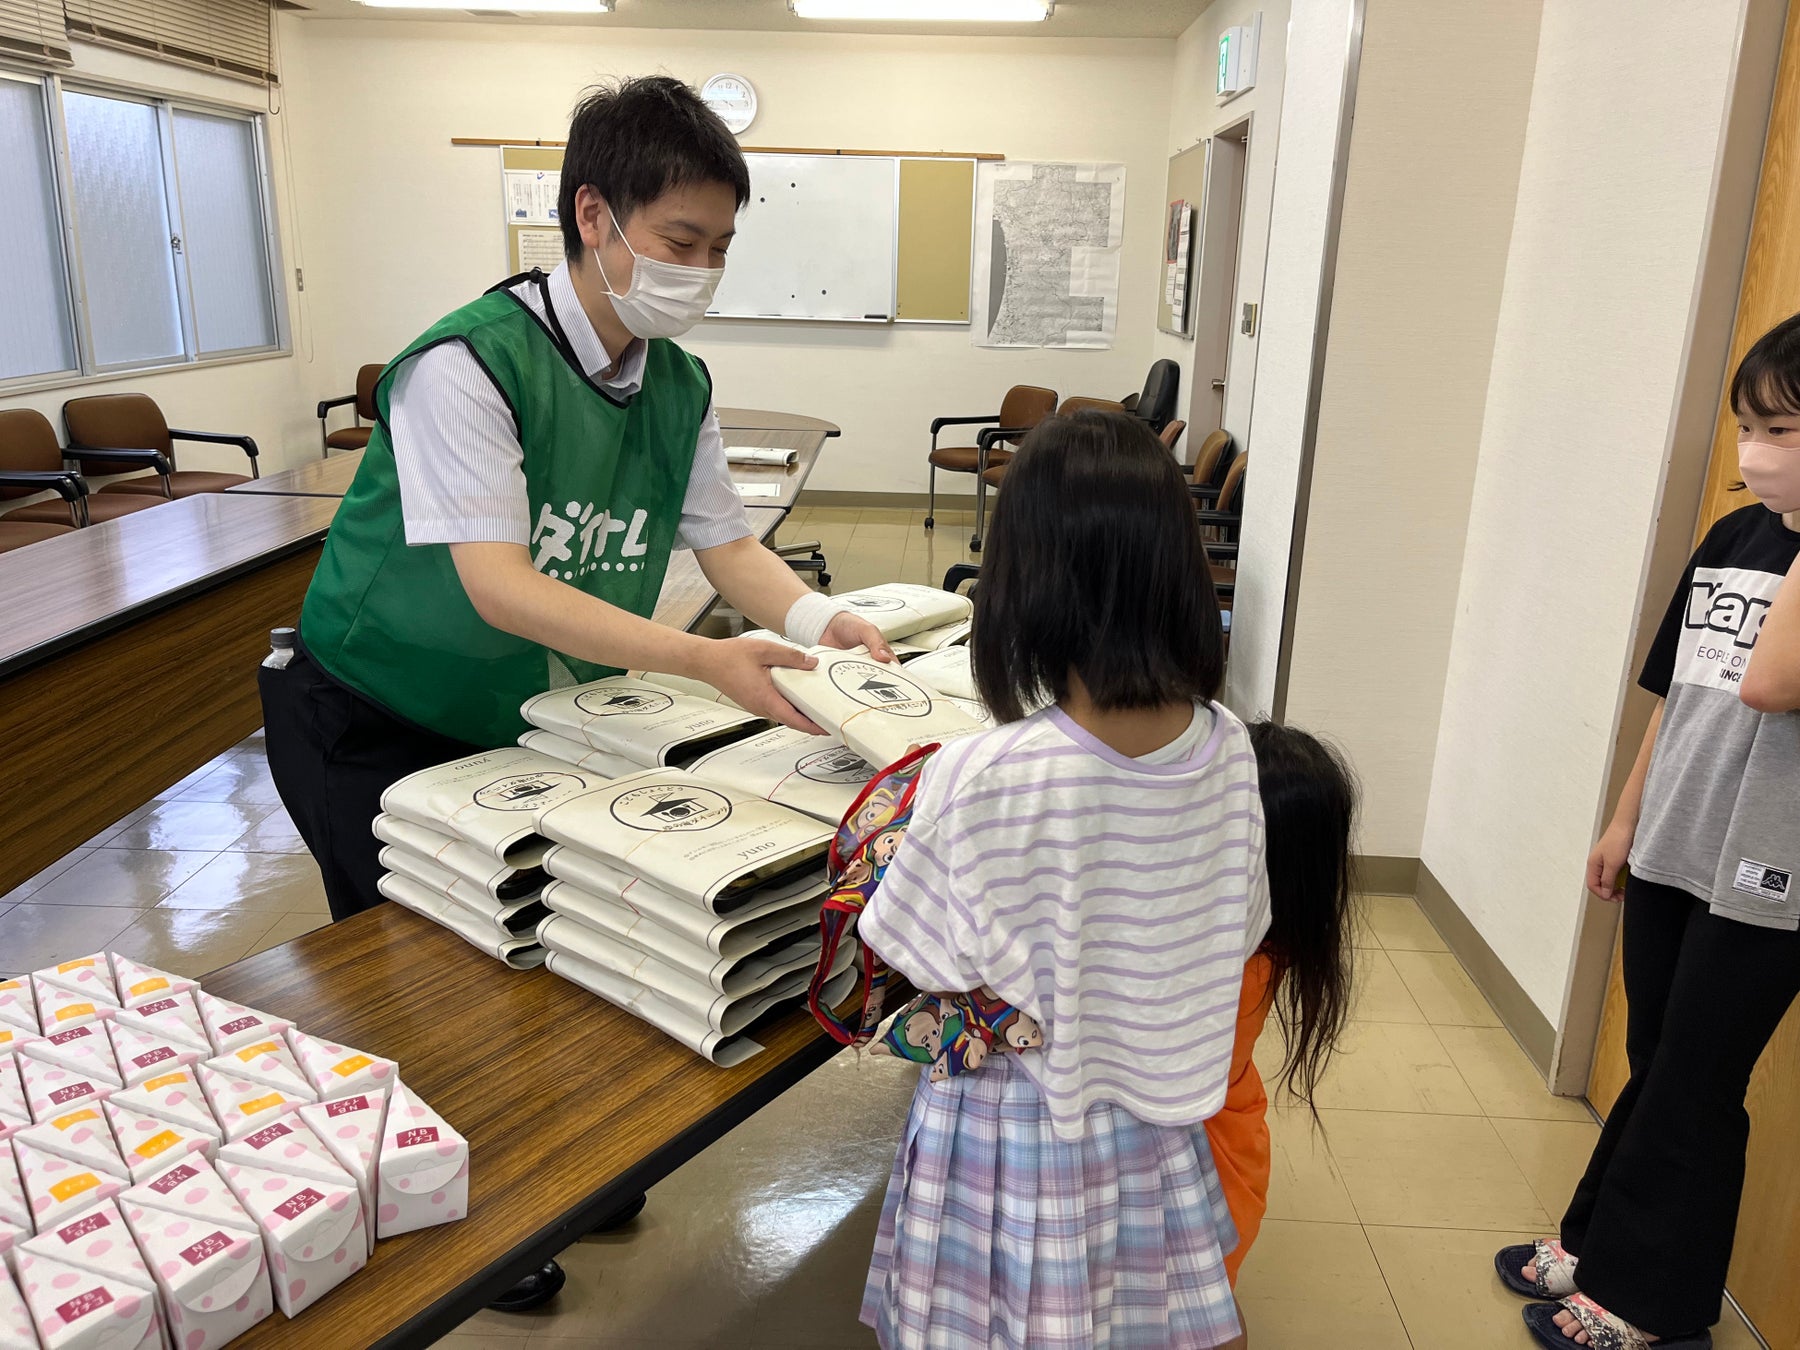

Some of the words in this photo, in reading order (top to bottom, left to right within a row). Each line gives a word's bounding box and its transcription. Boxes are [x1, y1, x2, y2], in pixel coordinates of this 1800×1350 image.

[454, 756, 493, 771] yuno
[736, 840, 777, 860] yuno
[407, 1128, 428, 1138] NB
[285, 1194, 307, 1208] NB
[191, 1238, 215, 1253] NB
